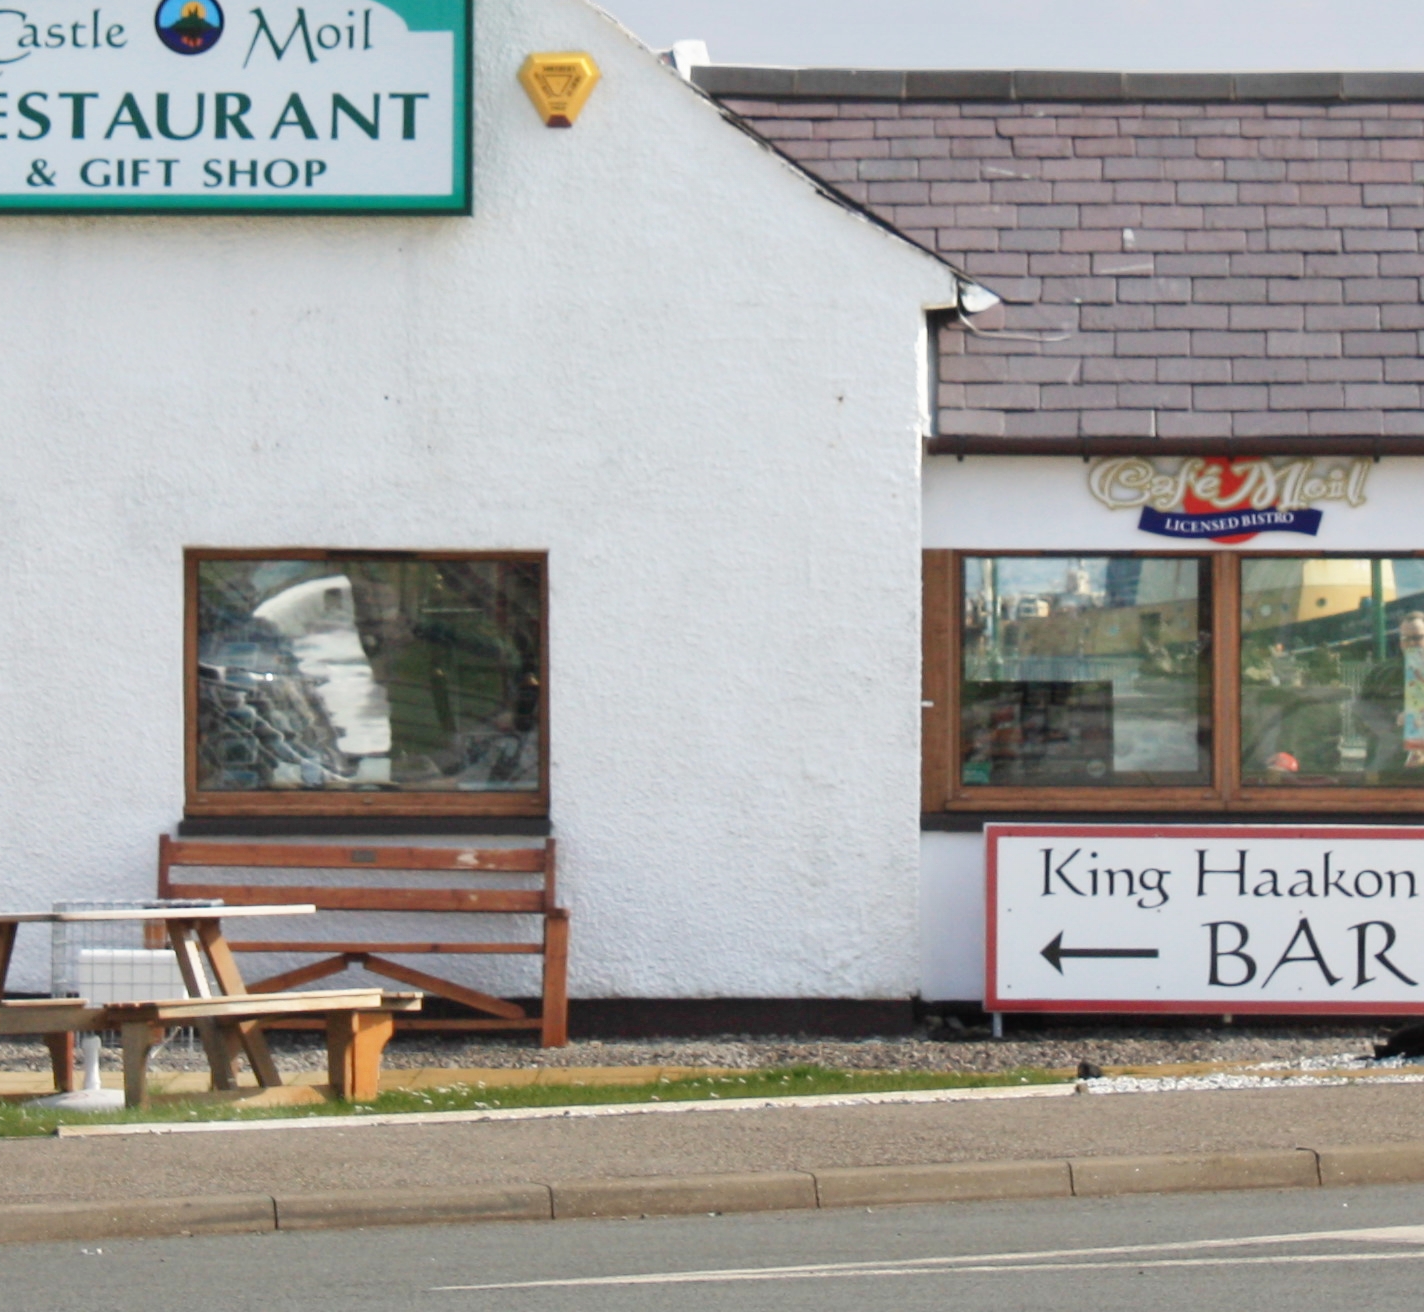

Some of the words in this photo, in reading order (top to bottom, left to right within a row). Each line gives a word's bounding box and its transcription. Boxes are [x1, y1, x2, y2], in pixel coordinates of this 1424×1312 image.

[243, 7, 374, 69] Moil
[25, 157, 56, 188] &
[79, 157, 180, 188] GIFT
[202, 157, 327, 188] SHOP
[1216, 457, 1372, 512] Moil
[1164, 516, 1240, 534] LICENSED
[1241, 510, 1295, 528] BISTRO
[1039, 847, 1171, 910] King
[1194, 848, 1419, 899] Haakon
[1200, 915, 1419, 990] BAR
